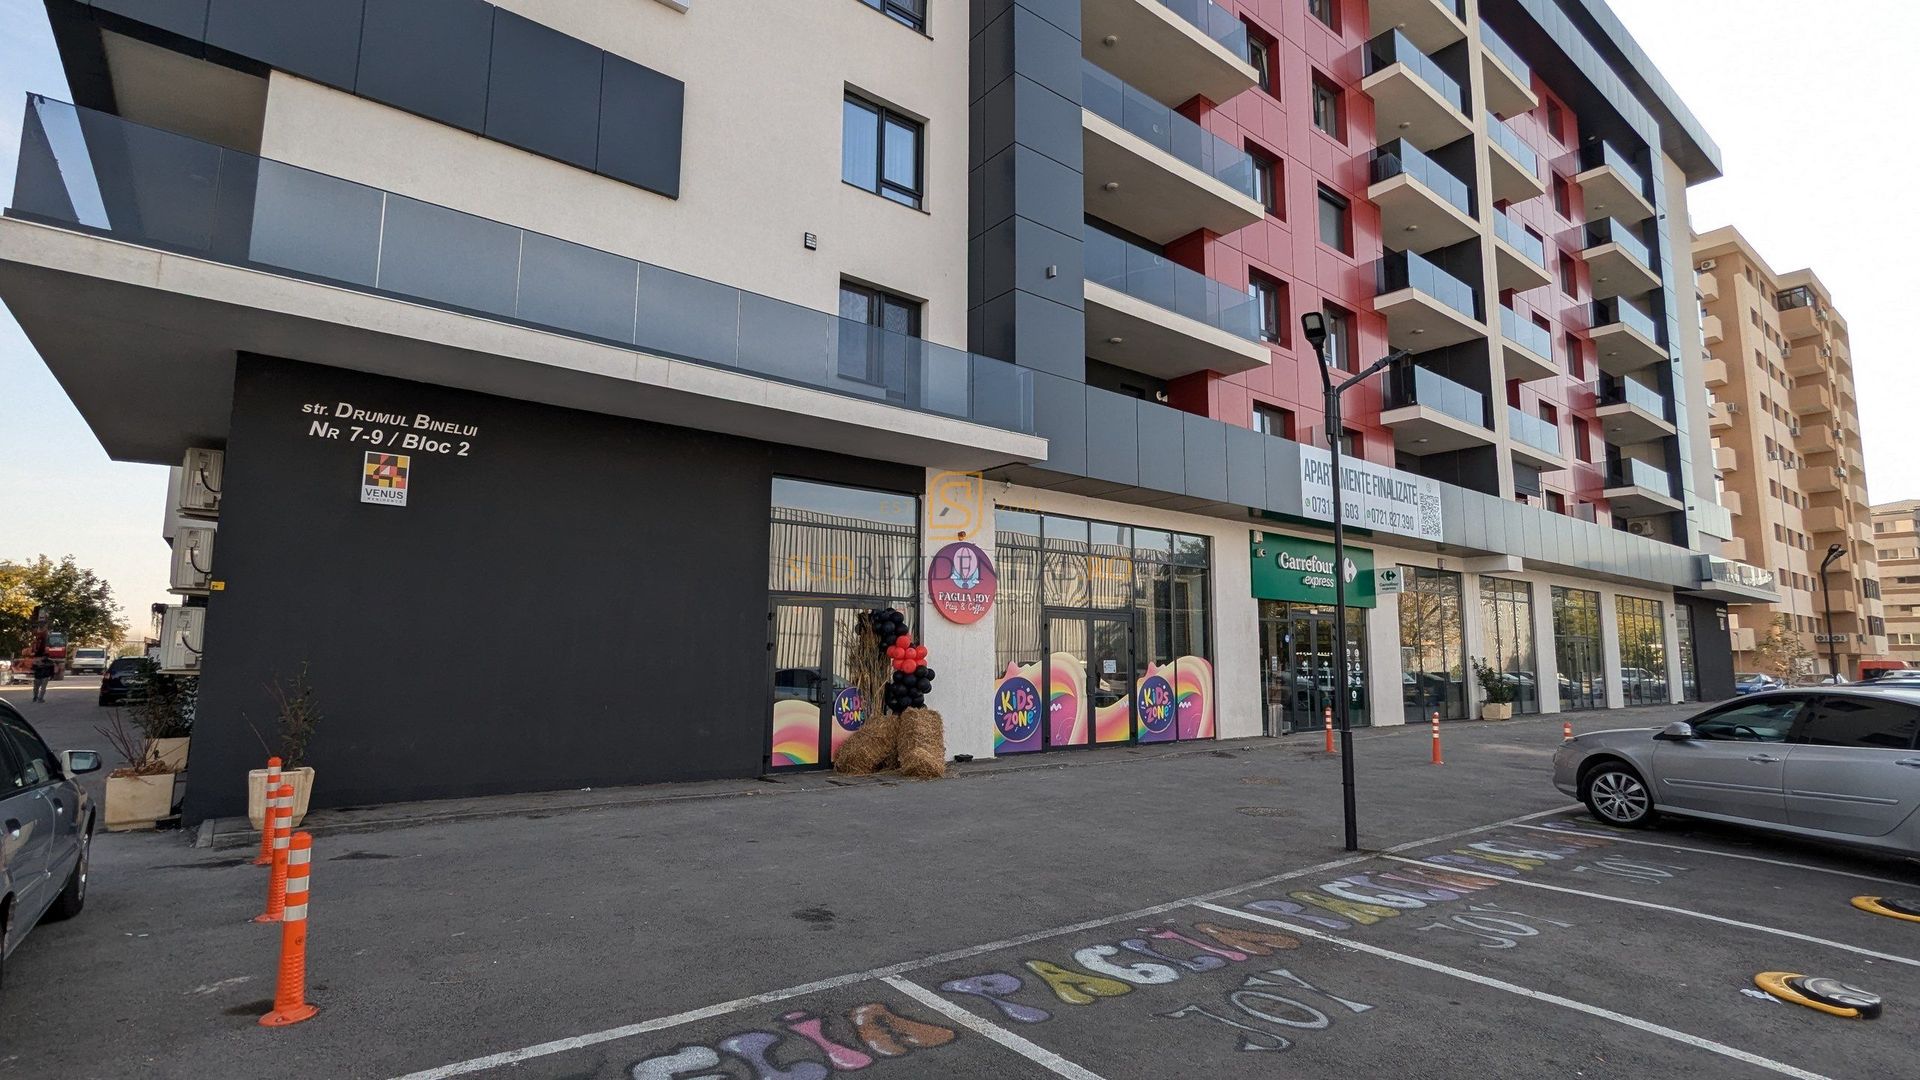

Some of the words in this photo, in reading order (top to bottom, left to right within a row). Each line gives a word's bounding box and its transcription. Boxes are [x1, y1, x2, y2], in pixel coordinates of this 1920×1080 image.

[301, 402, 329, 416] str.
[349, 426, 385, 446] 7-9
[401, 433, 452, 454] Bloc
[456, 441, 471, 457] 2
[1304, 458, 1372, 496] APARMENTE
[1372, 474, 1418, 506] FINALIZATE
[364, 487, 405, 500] VENUS
[1279, 551, 1335, 576] Carrefour
[1303, 574, 1335, 589] express
[938, 591, 972, 603] PAGLIA
[972, 593, 991, 604] JOY
[1152, 967, 1376, 1053] JOY
